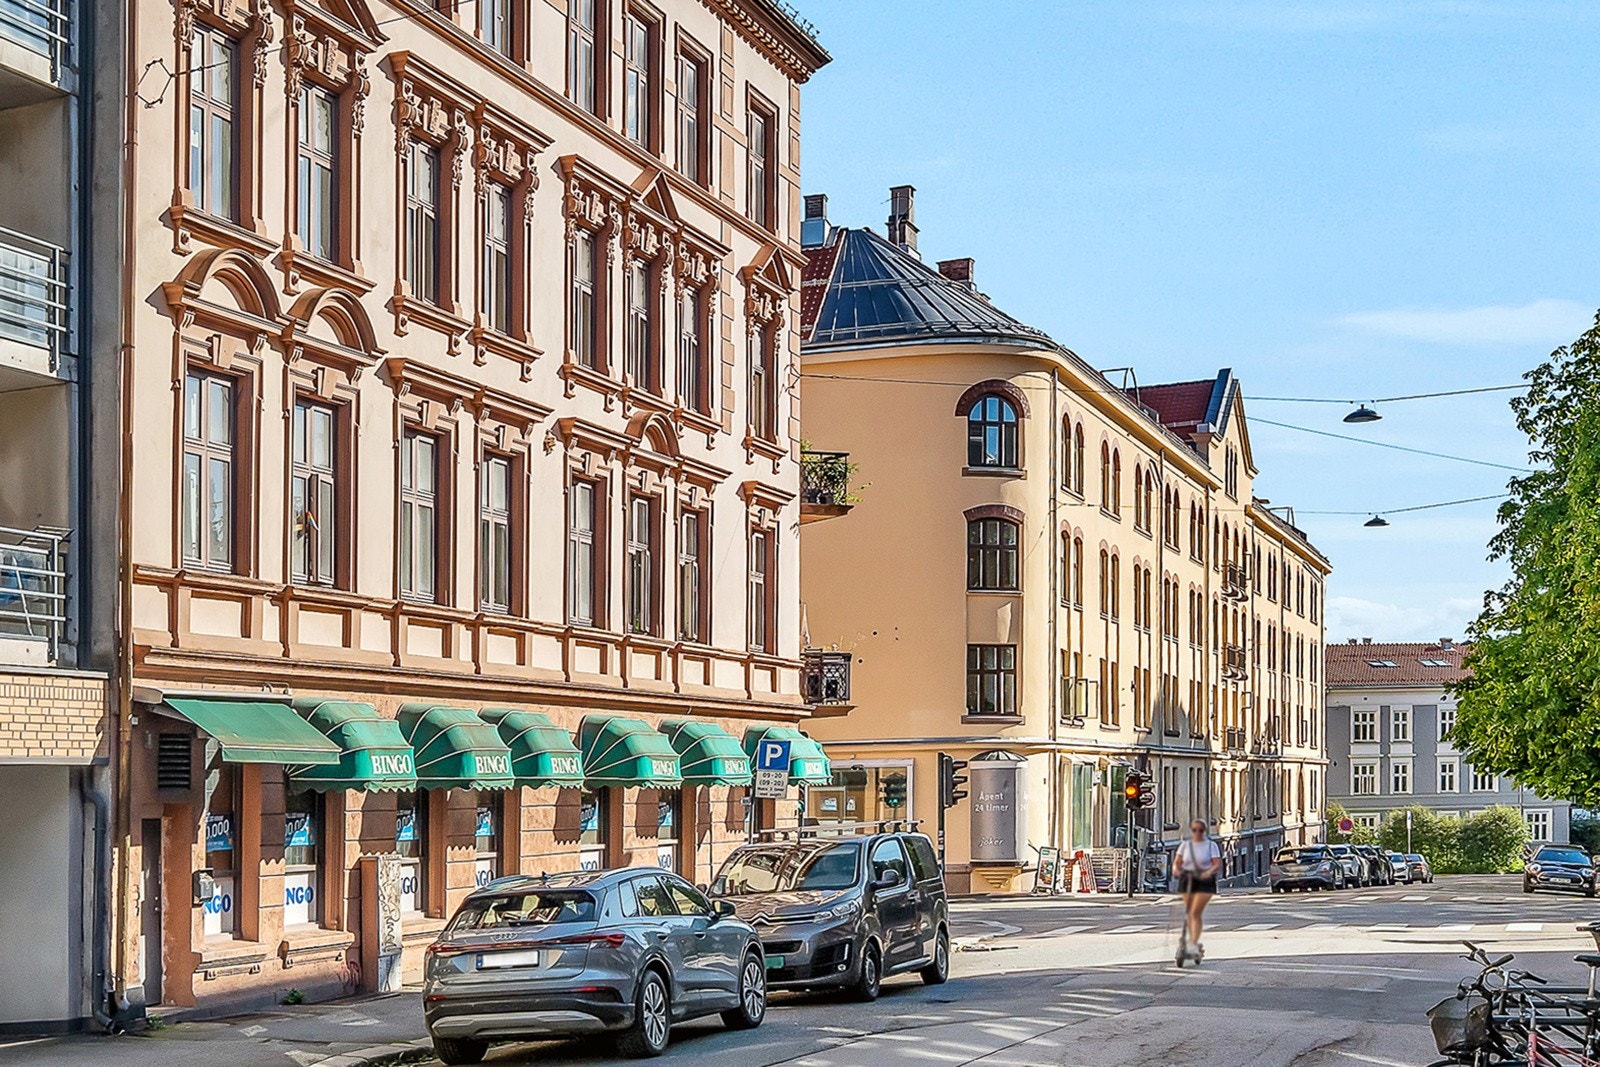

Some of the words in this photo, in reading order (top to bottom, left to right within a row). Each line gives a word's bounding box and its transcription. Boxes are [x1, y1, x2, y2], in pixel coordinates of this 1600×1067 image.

[371, 754, 412, 775] BINGO
[475, 755, 510, 774] BINGO
[764, 743, 783, 767] P
[550, 756, 581, 775] BINGO
[651, 759, 676, 776] BINGO
[724, 759, 747, 775] BINGO
[974, 803, 984, 812] 24
[986, 803, 1009, 812] timer
